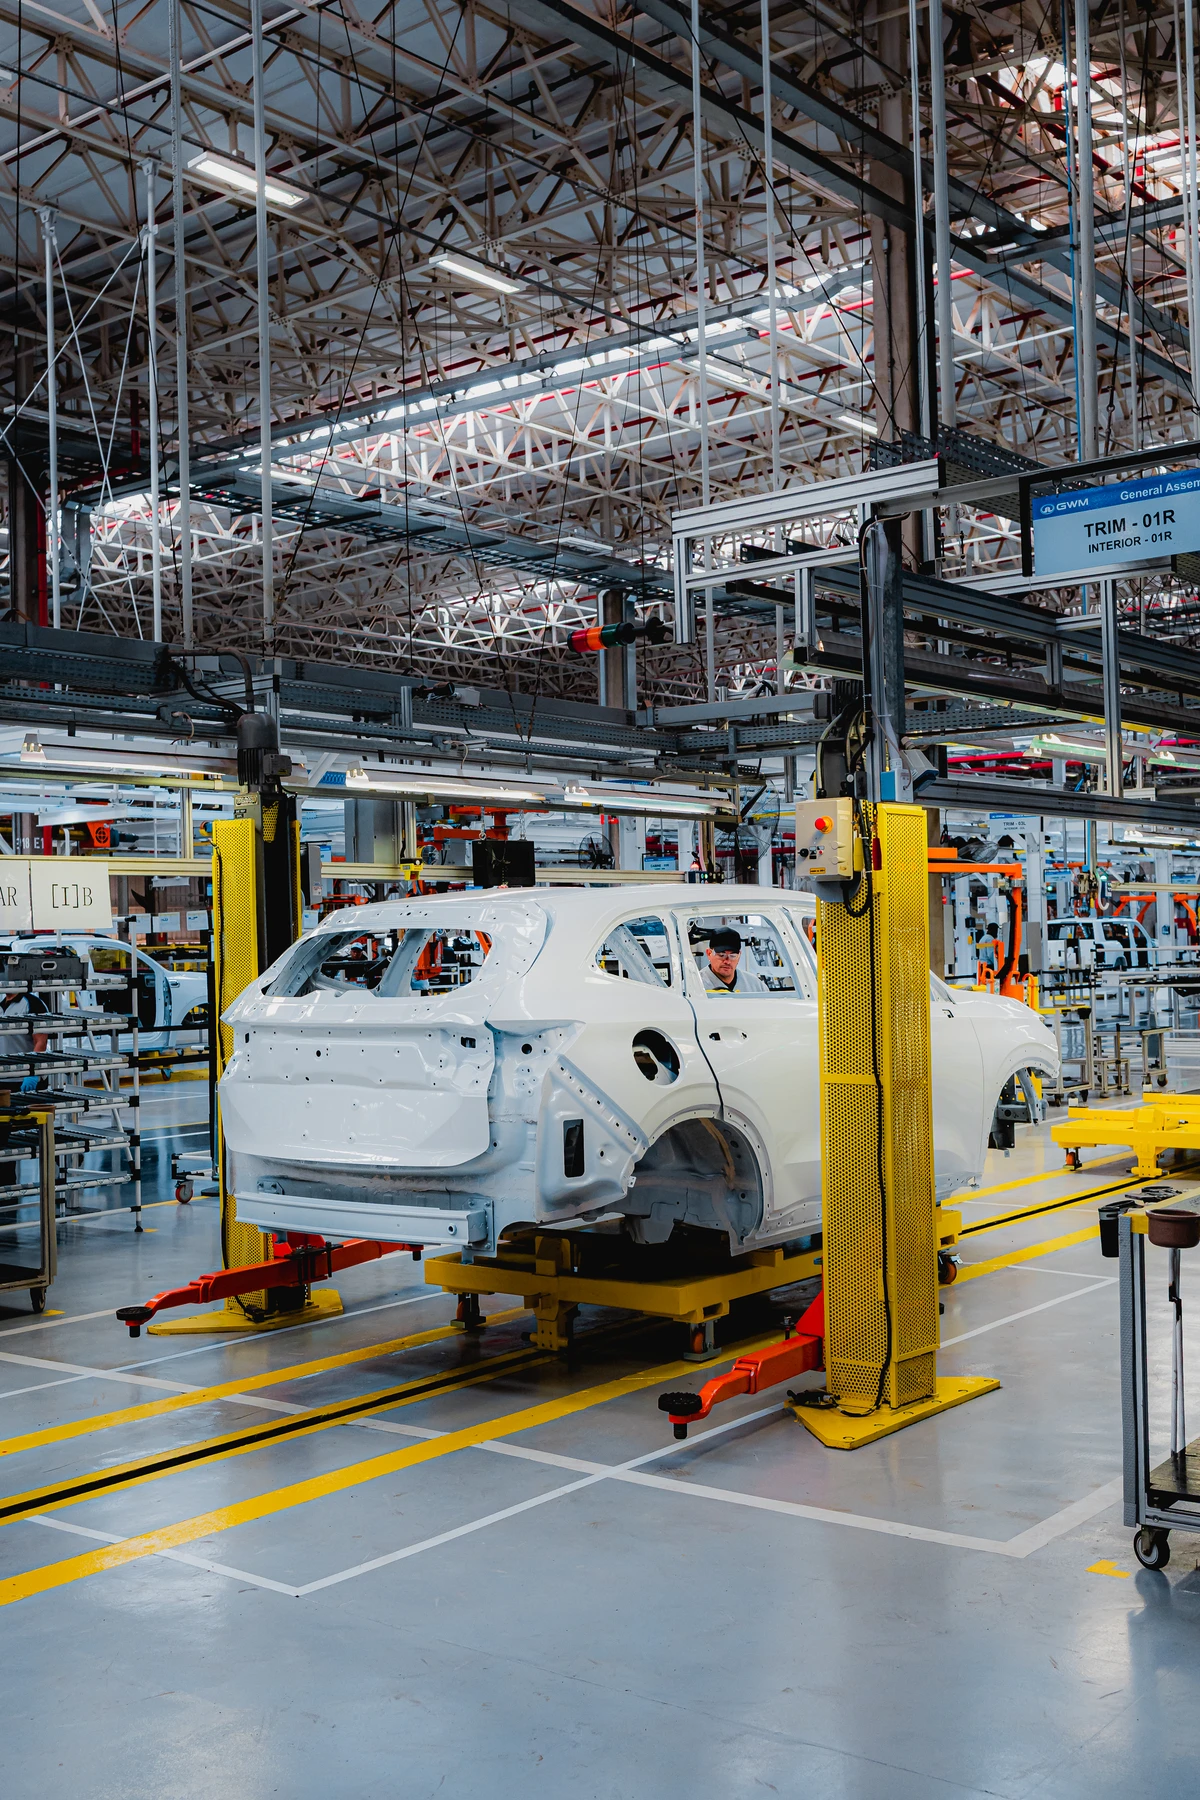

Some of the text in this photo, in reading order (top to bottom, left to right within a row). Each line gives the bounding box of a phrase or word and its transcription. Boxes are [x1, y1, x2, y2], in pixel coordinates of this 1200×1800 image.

[1120, 484, 1163, 501] General
[1056, 497, 1089, 511] GWM
[1084, 518, 1126, 537] TRIM
[1142, 509, 1176, 528] 01R
[1088, 536, 1141, 553] INTERIOR
[1151, 531, 1172, 543] 01R
